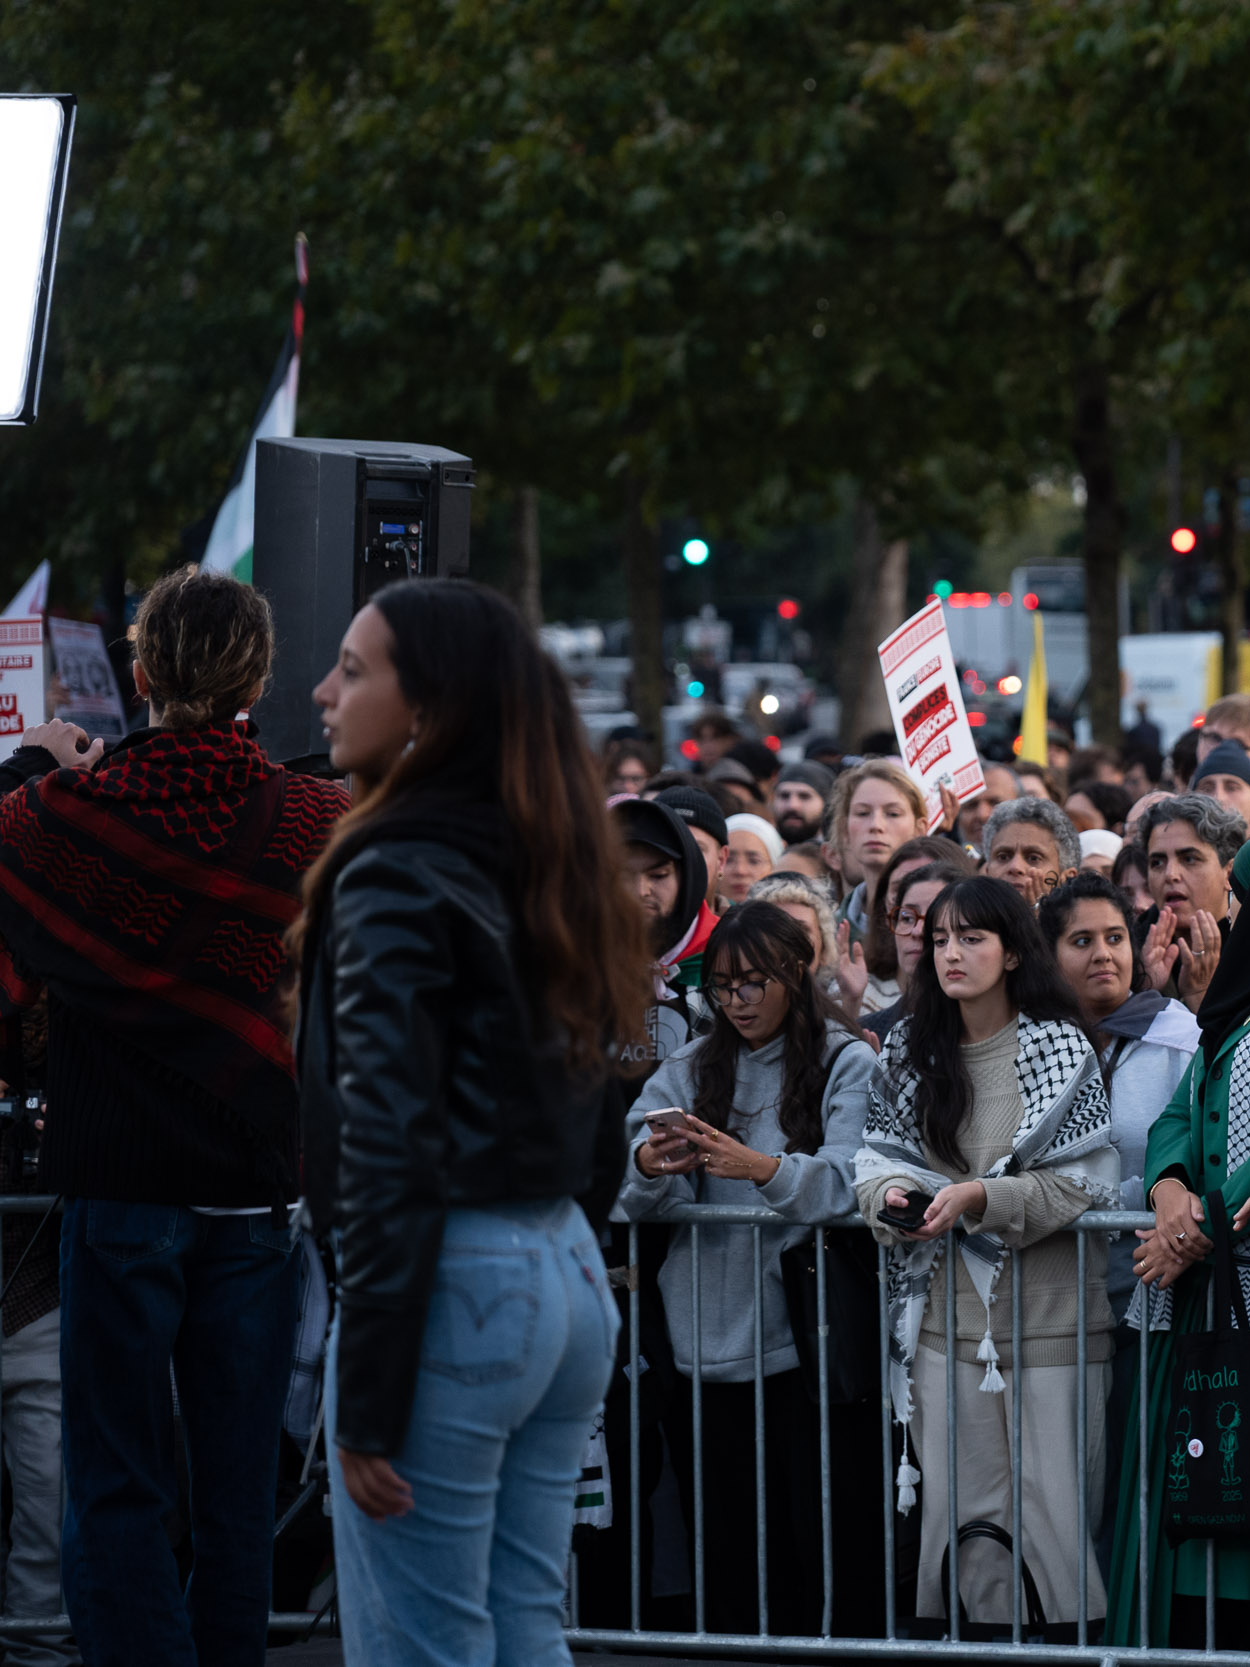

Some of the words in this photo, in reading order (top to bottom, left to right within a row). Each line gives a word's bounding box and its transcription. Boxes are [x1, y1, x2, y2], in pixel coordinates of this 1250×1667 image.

[903, 685, 947, 731] COMPLICES
[620, 1042, 657, 1061] ACE
[1221, 1489, 1244, 1502] 2025
